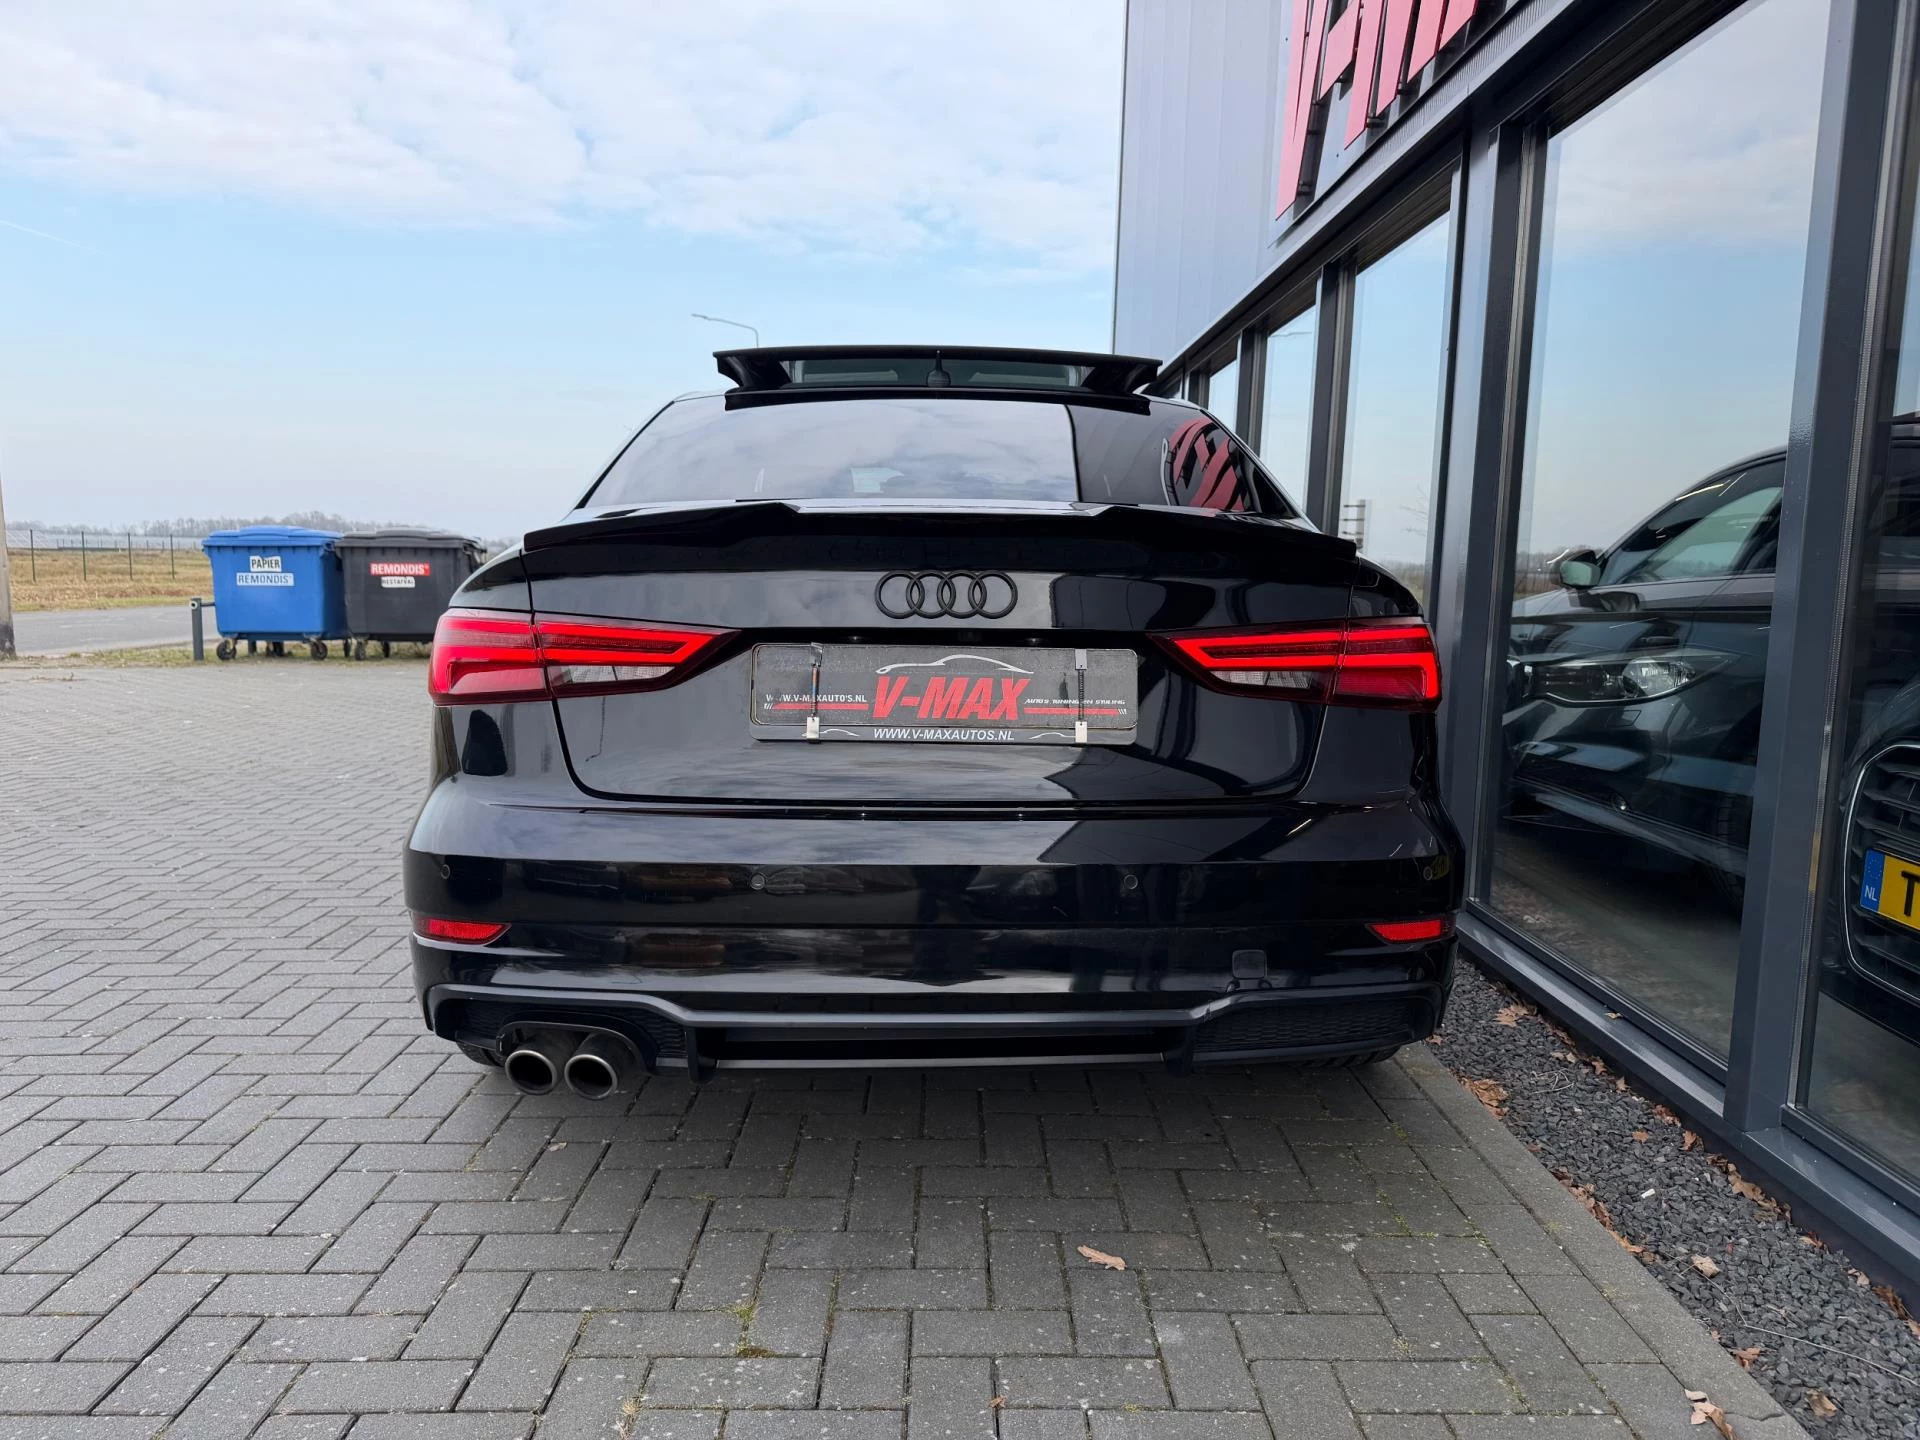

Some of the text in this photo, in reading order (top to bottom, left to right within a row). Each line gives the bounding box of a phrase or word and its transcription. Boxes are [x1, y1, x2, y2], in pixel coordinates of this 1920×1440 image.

[251, 559, 280, 569] PAPIER
[872, 676, 1031, 720] V-MAX
[873, 728, 1015, 741] WWW.V-MAXAUTOS.NL
[1864, 884, 1878, 902] NL
